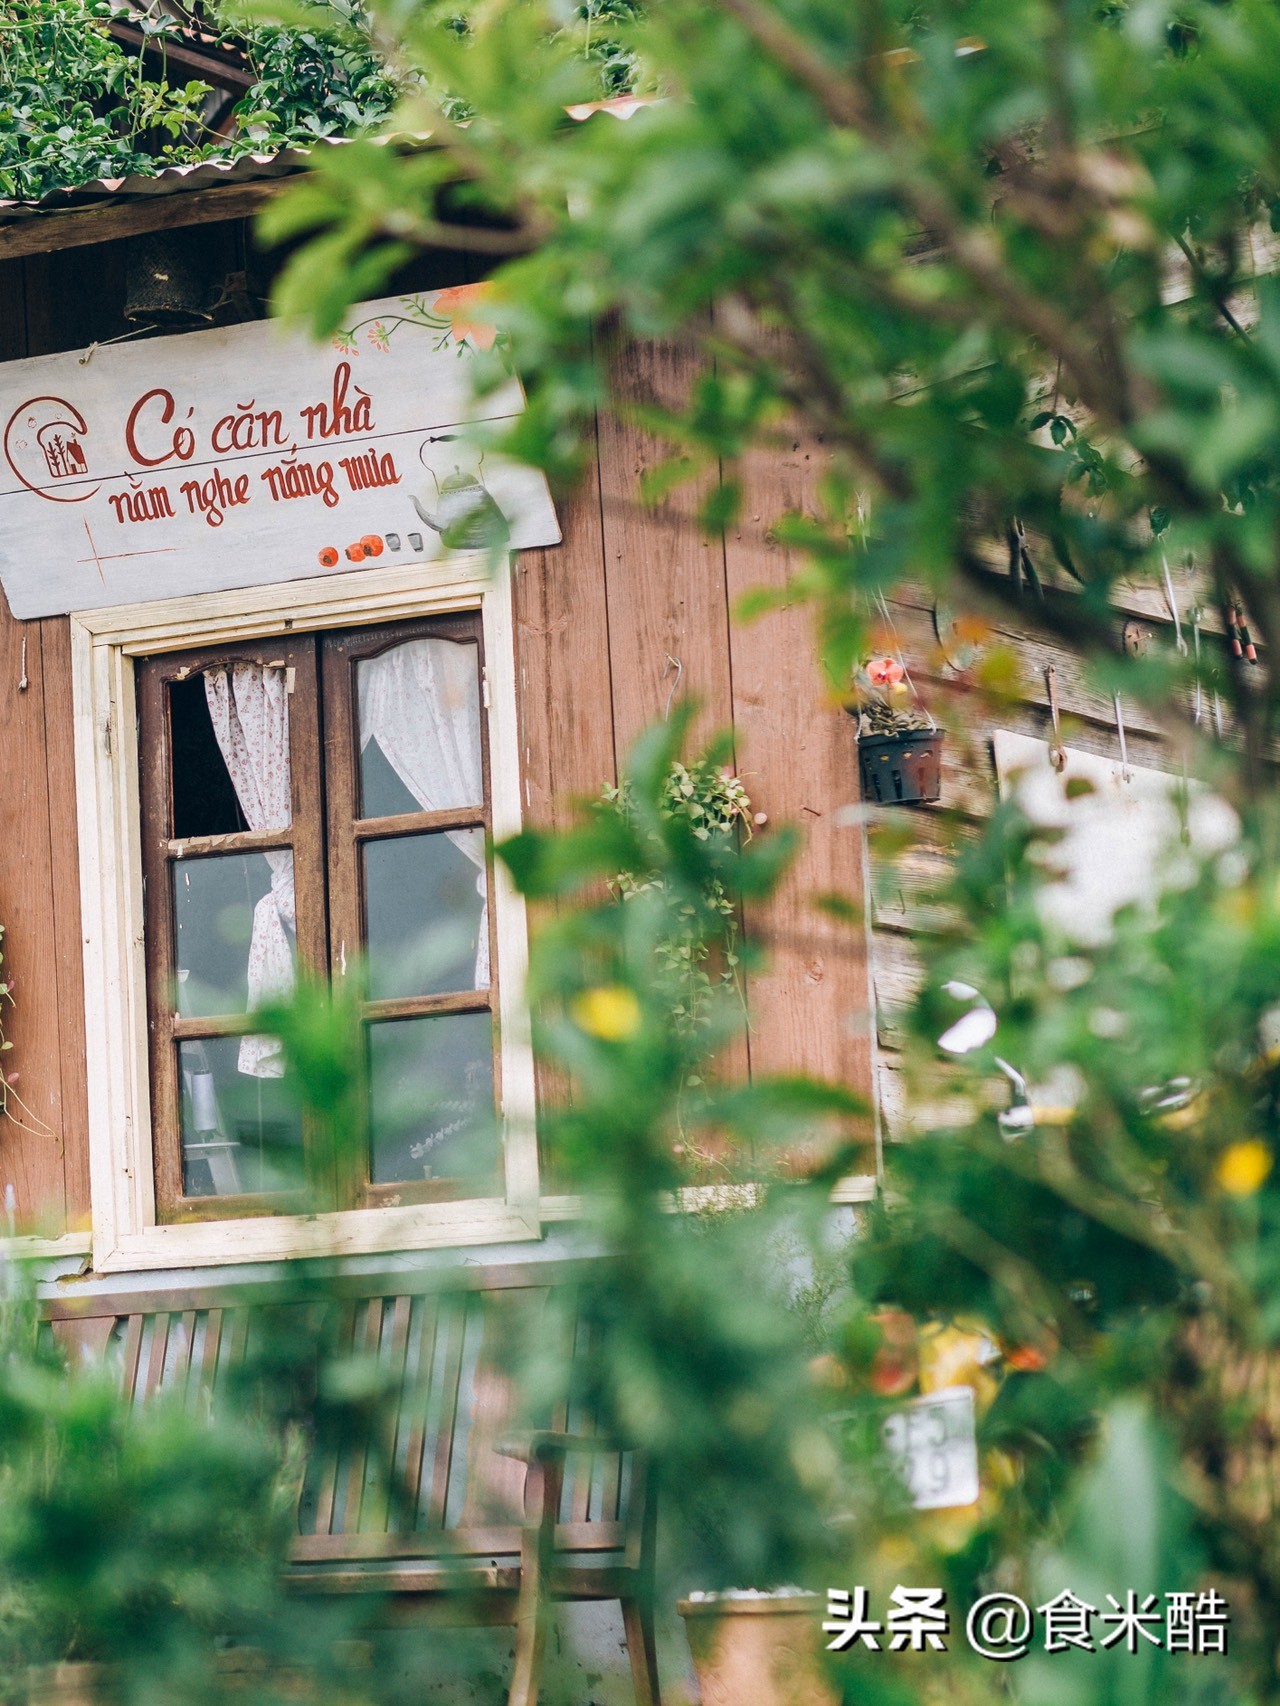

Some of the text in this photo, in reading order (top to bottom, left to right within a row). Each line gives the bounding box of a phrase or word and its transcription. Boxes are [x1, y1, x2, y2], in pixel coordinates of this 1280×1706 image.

[125, 361, 377, 467] Có căn nhà
[108, 471, 176, 524] nằm
[180, 468, 252, 528] nghe
[261, 443, 340, 508] nắng
